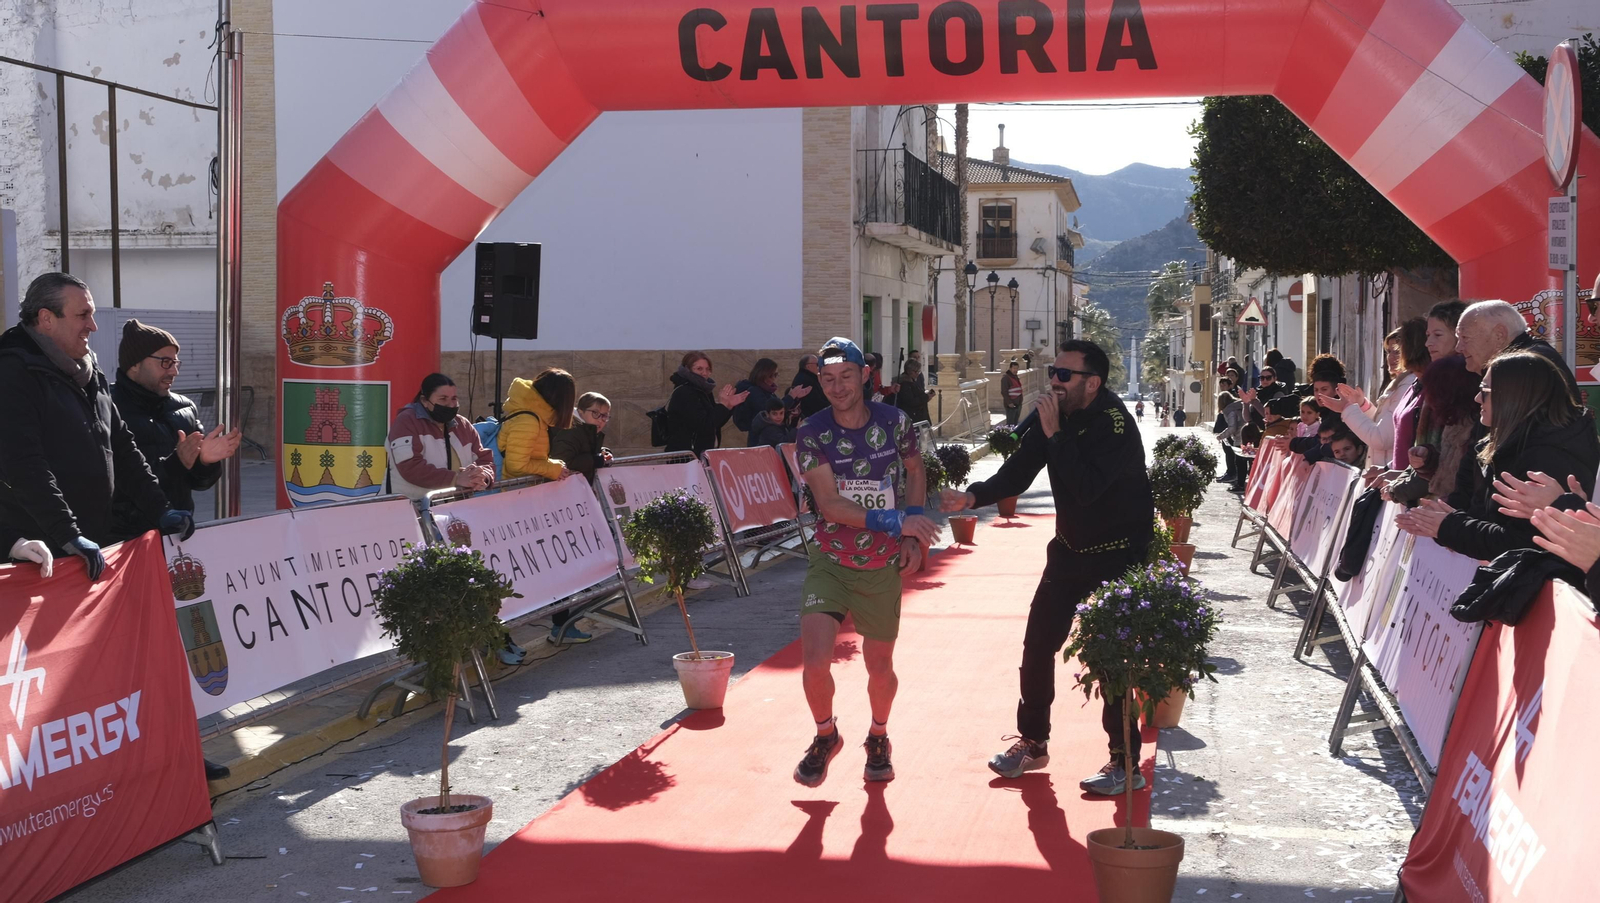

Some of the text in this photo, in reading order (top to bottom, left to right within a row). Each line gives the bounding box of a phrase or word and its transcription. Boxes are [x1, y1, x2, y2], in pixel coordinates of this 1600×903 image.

[678, 0, 1158, 82] CANTORIA
[739, 472, 784, 504] VEOLIA
[852, 493, 886, 509] 366
[482, 501, 590, 546] AYUNTAMIENTO DE
[389, 537, 409, 558] DE
[489, 523, 605, 585] CANTORIA
[1452, 750, 1547, 898] TEAMERGY
